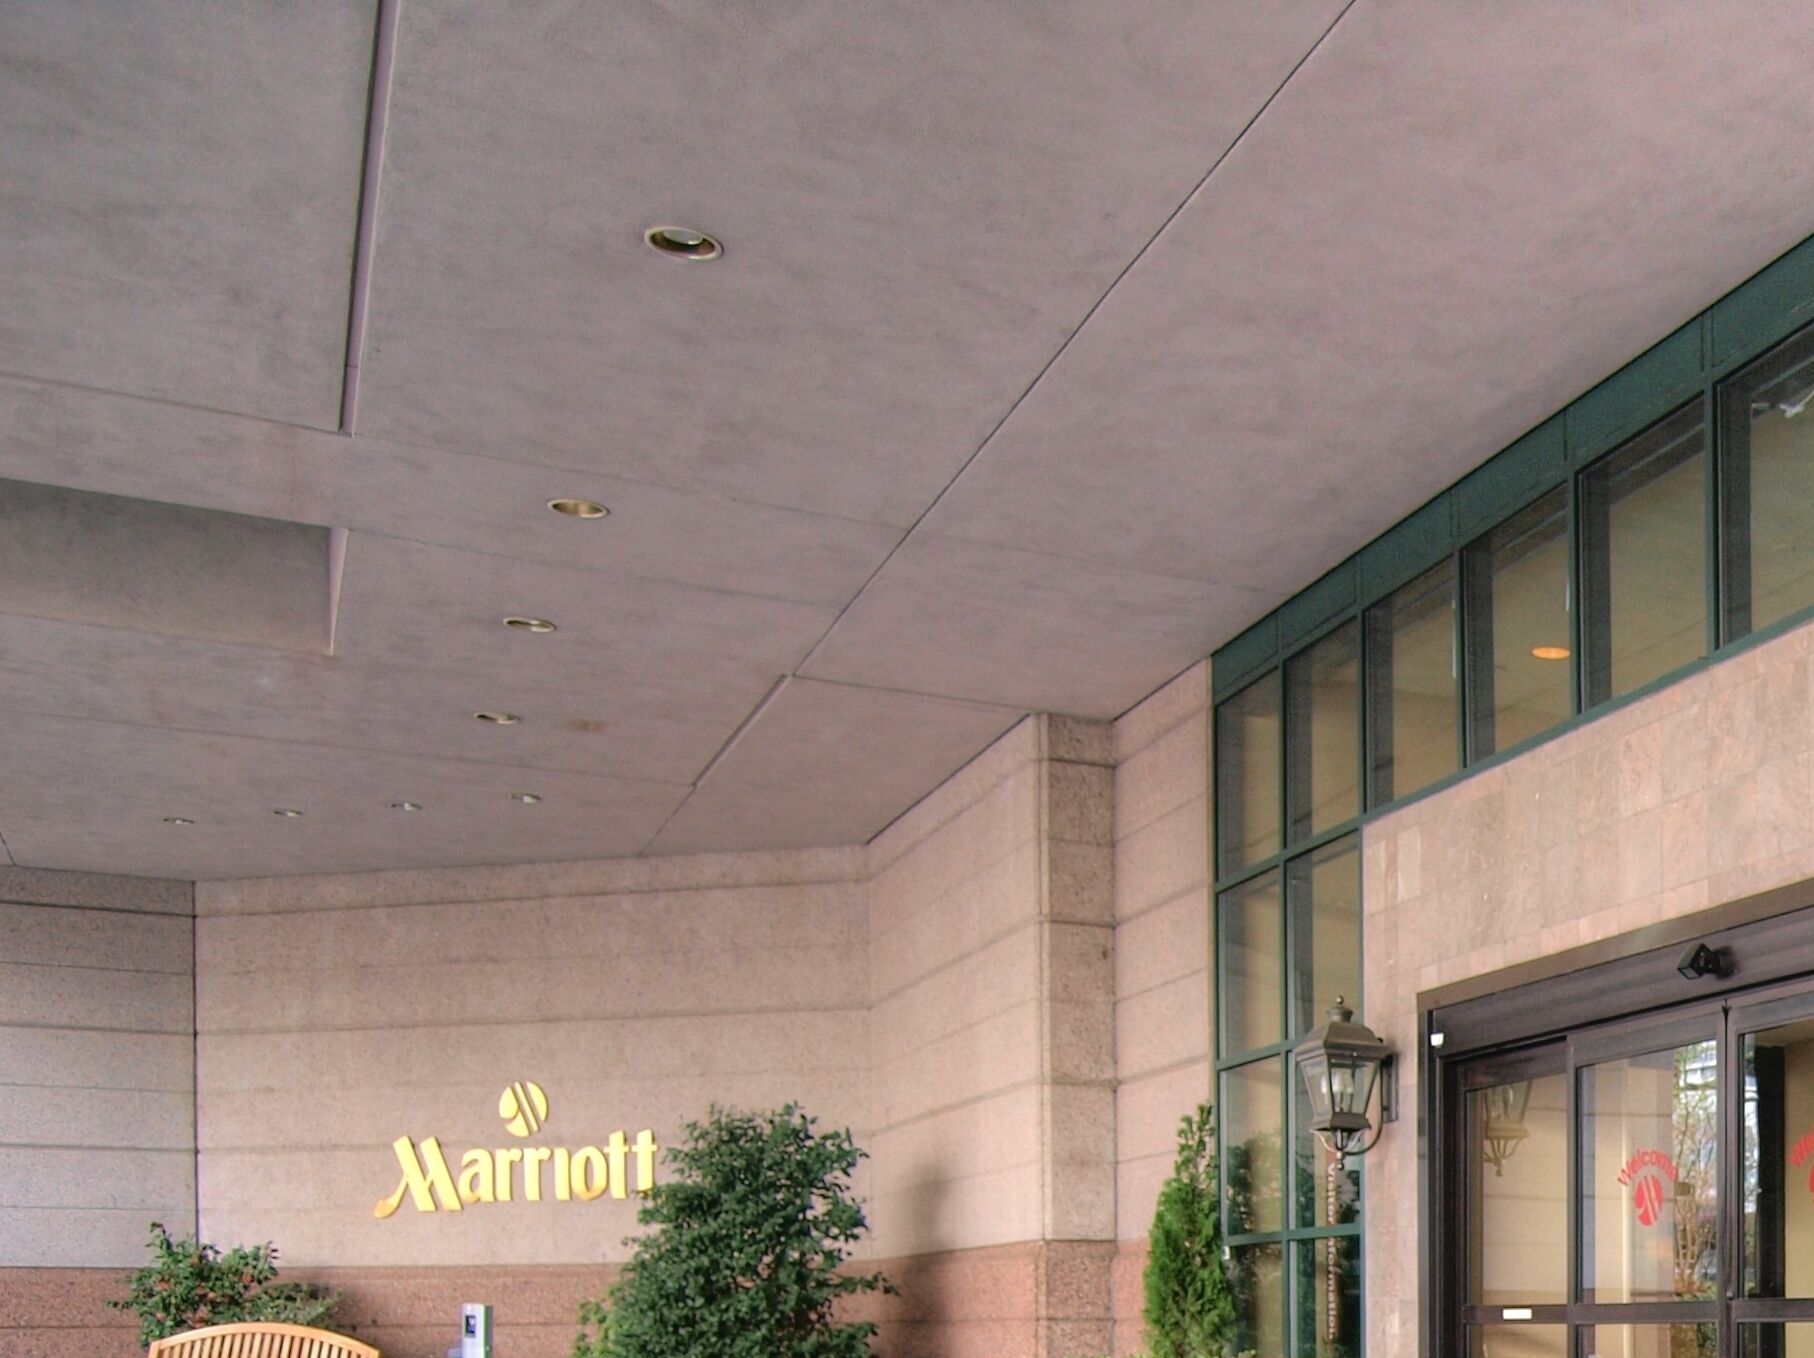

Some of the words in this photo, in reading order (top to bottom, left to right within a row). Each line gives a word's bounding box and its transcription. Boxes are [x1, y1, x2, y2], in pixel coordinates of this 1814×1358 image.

[373, 1129, 658, 1218] Marriott
[1327, 1162, 1336, 1225] Visitor
[1617, 1148, 1680, 1186] Welcome
[1327, 1236, 1337, 1340] nformation
